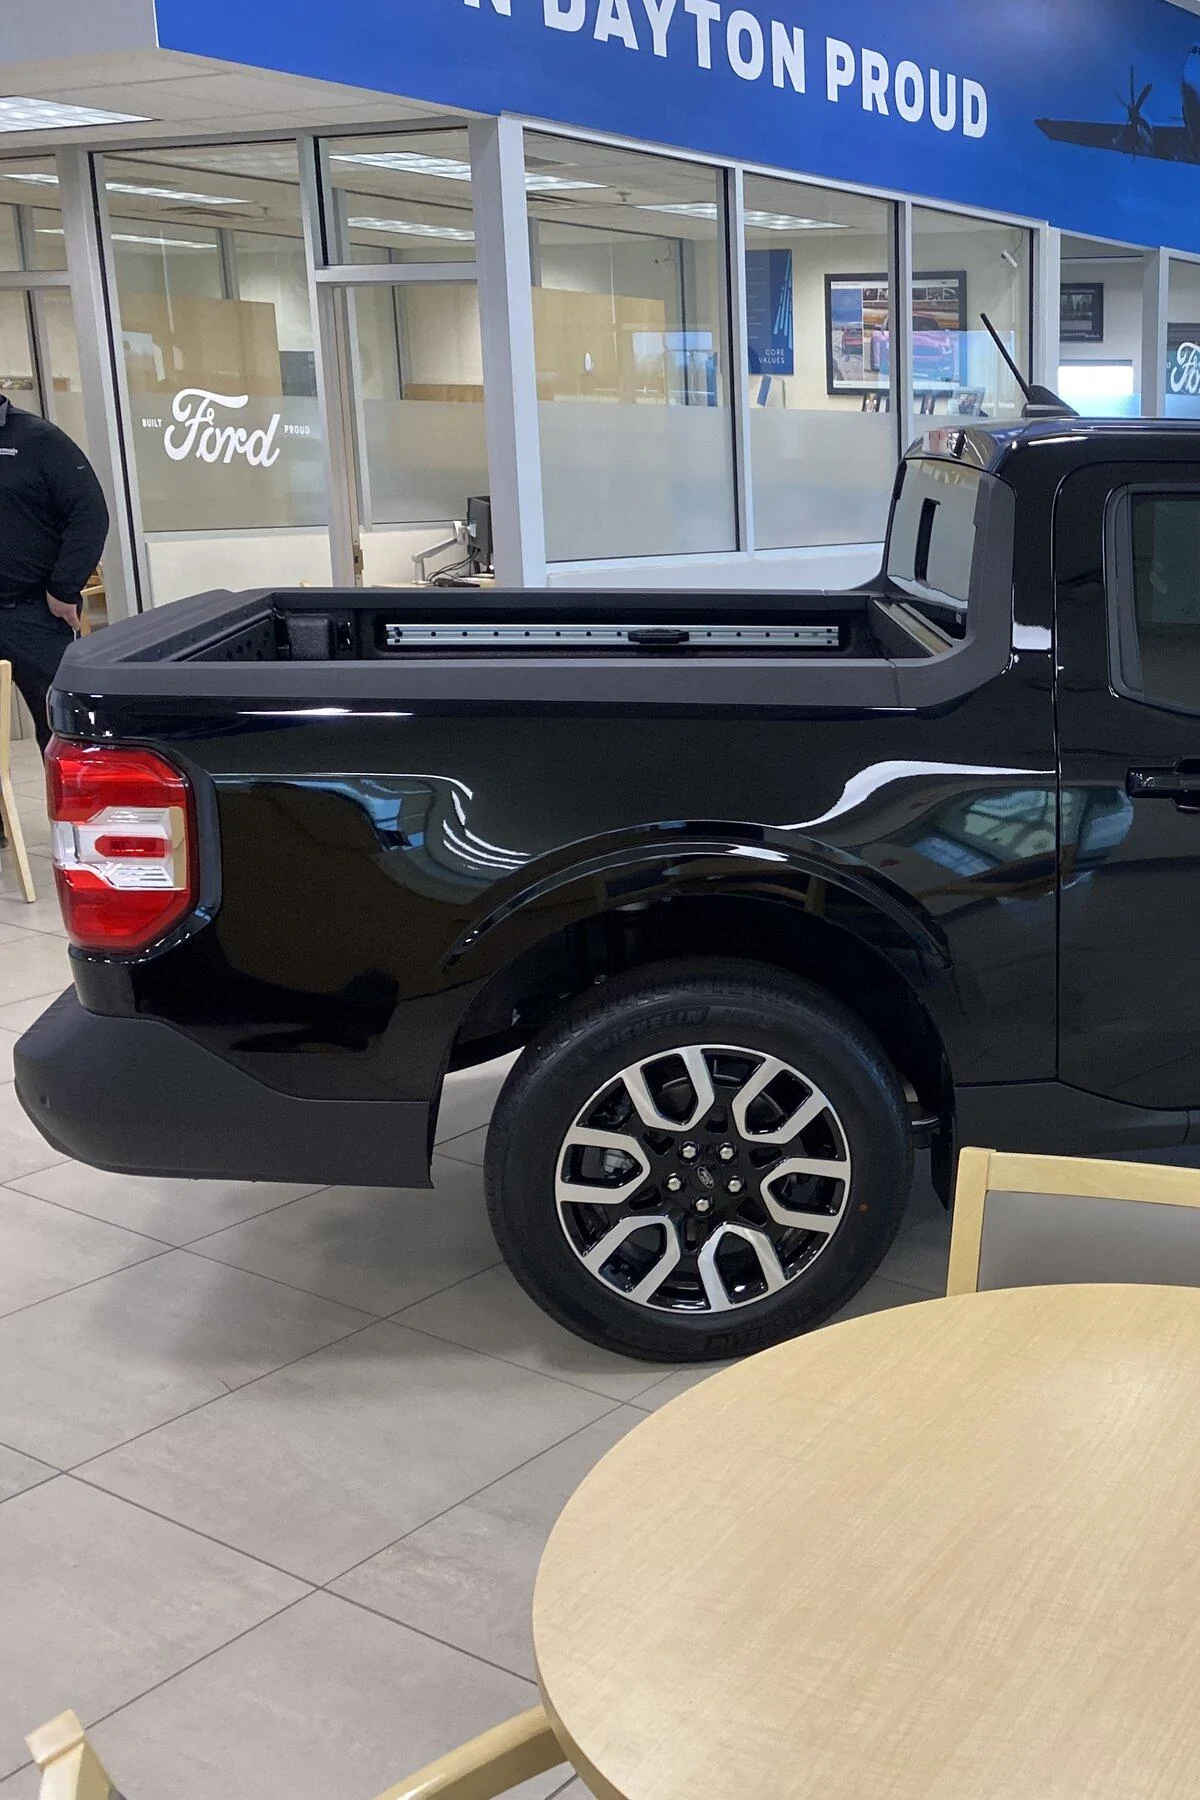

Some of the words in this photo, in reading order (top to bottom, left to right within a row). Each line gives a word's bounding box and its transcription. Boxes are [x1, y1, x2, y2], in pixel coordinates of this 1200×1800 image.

[826, 36, 988, 138] PROUD
[765, 348, 785, 356] CORE
[142, 418, 162, 427] BUILT
[164, 388, 280, 467] Ford
[284, 424, 311, 435] PROUD
